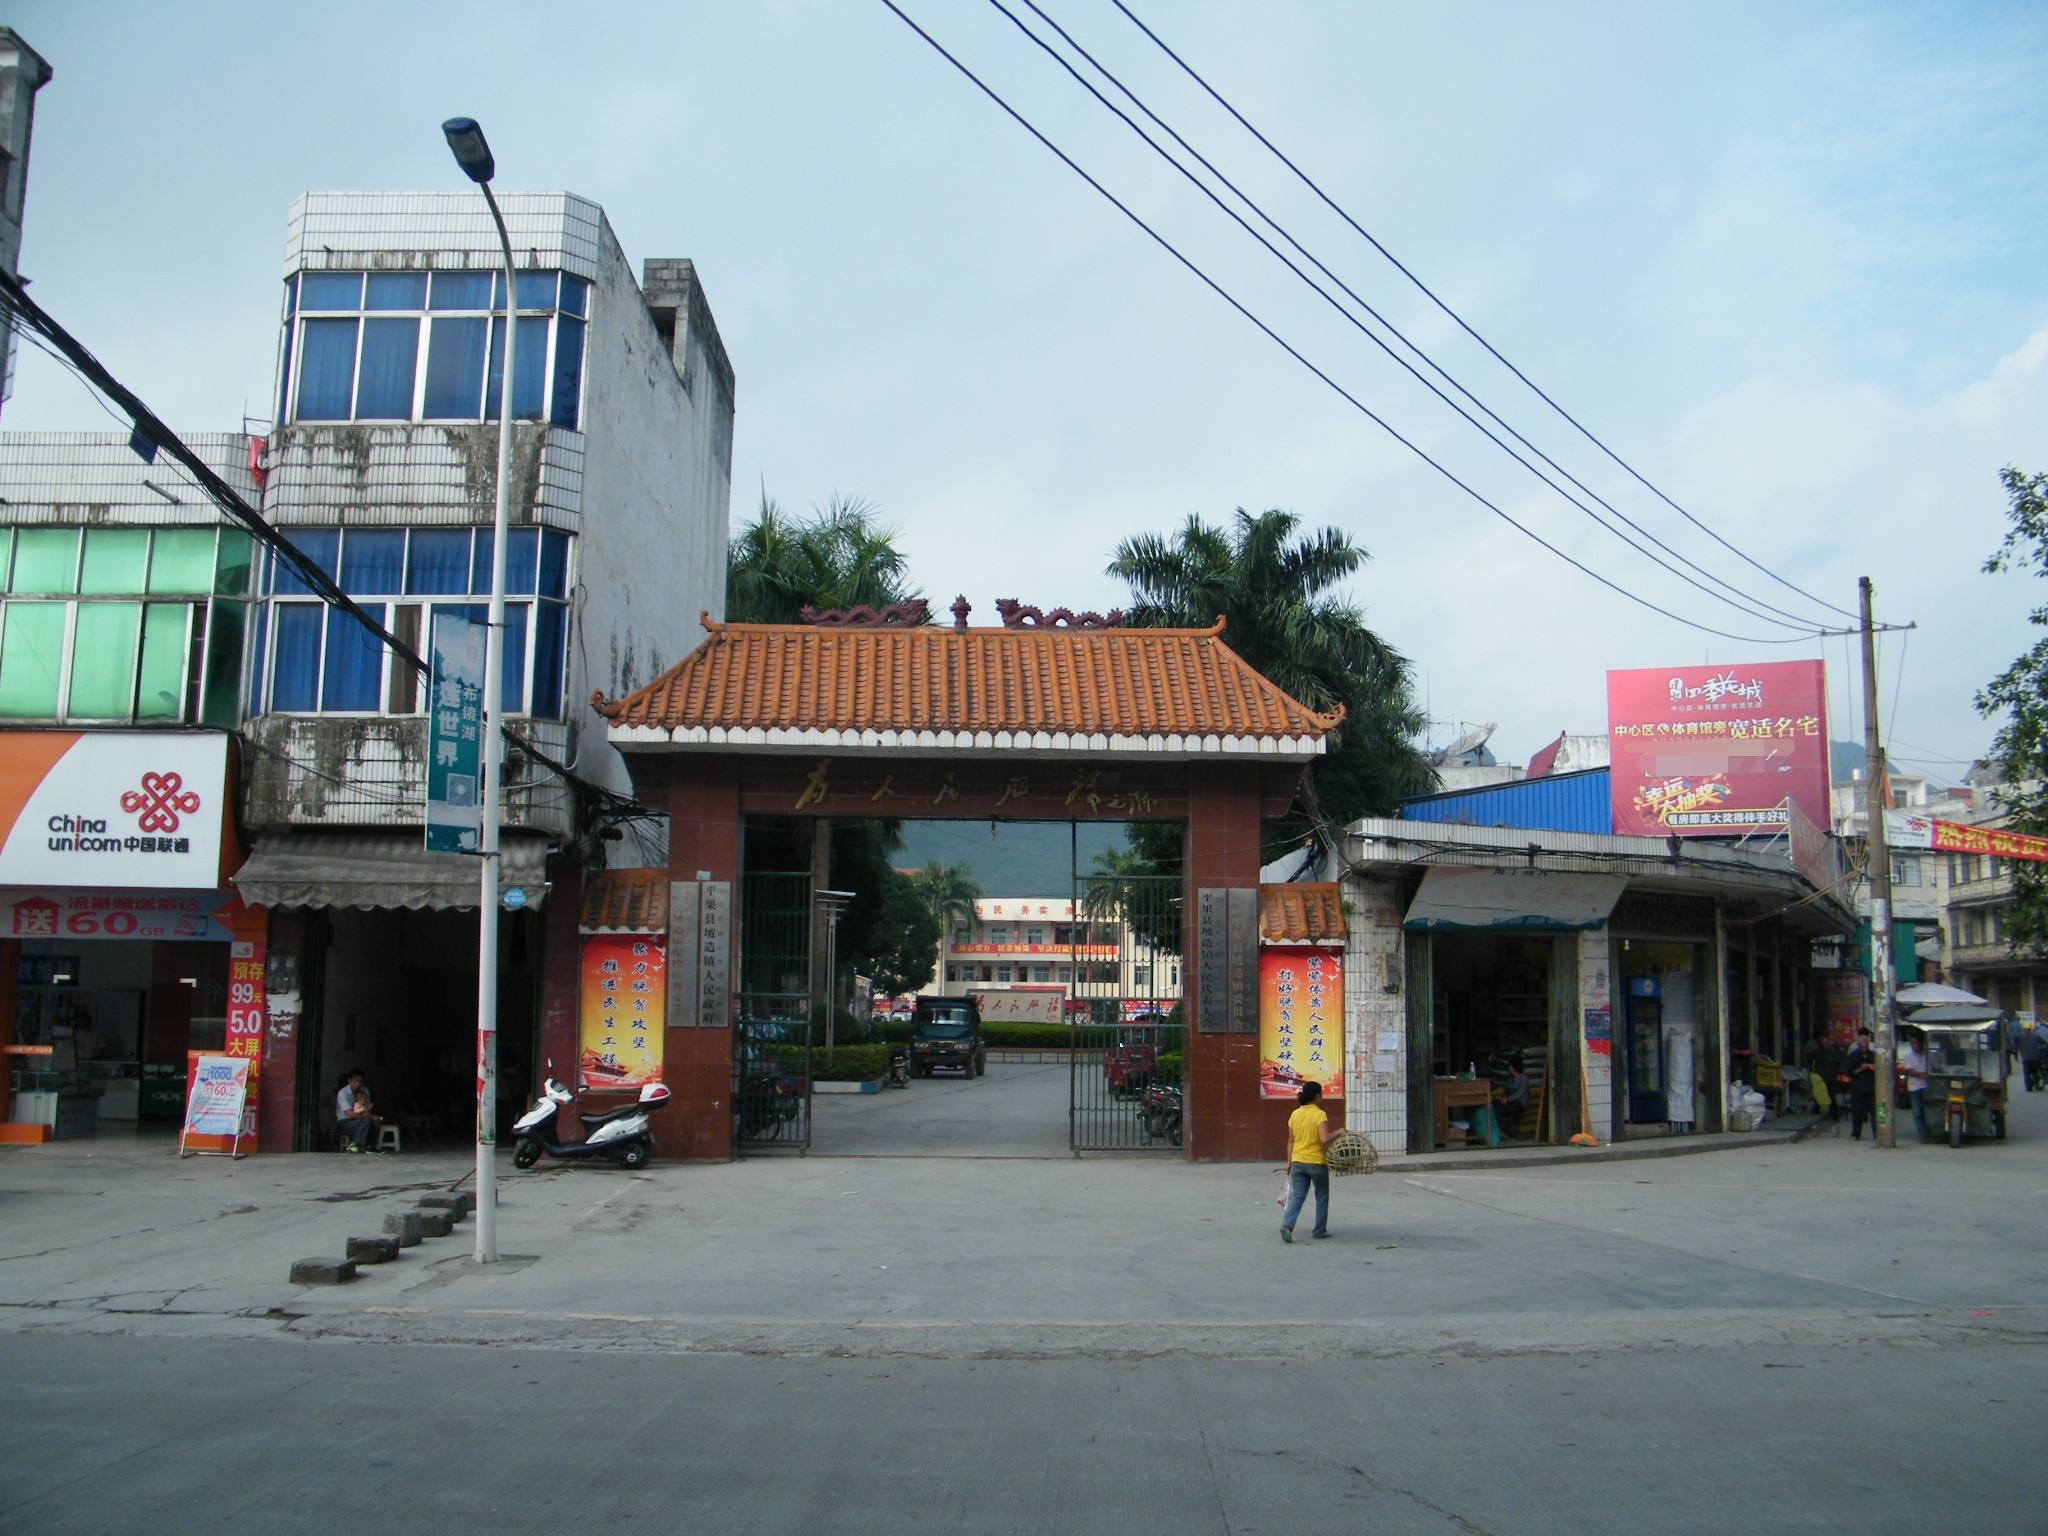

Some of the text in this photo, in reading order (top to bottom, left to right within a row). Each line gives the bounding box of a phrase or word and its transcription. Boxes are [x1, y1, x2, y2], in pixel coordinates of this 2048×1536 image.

[1615, 715, 1820, 739] 中心区 体育馆旁 宽适名宅
[1641, 777, 1690, 812] 幸运
[48, 815, 106, 833] China
[48, 834, 190, 853] unicom 中国联通
[19, 908, 54, 936] 送
[67, 911, 165, 936] 60 GB
[233, 961, 265, 981] 预存
[230, 1010, 262, 1034] 5.0
[229, 1037, 260, 1057] 大屏
